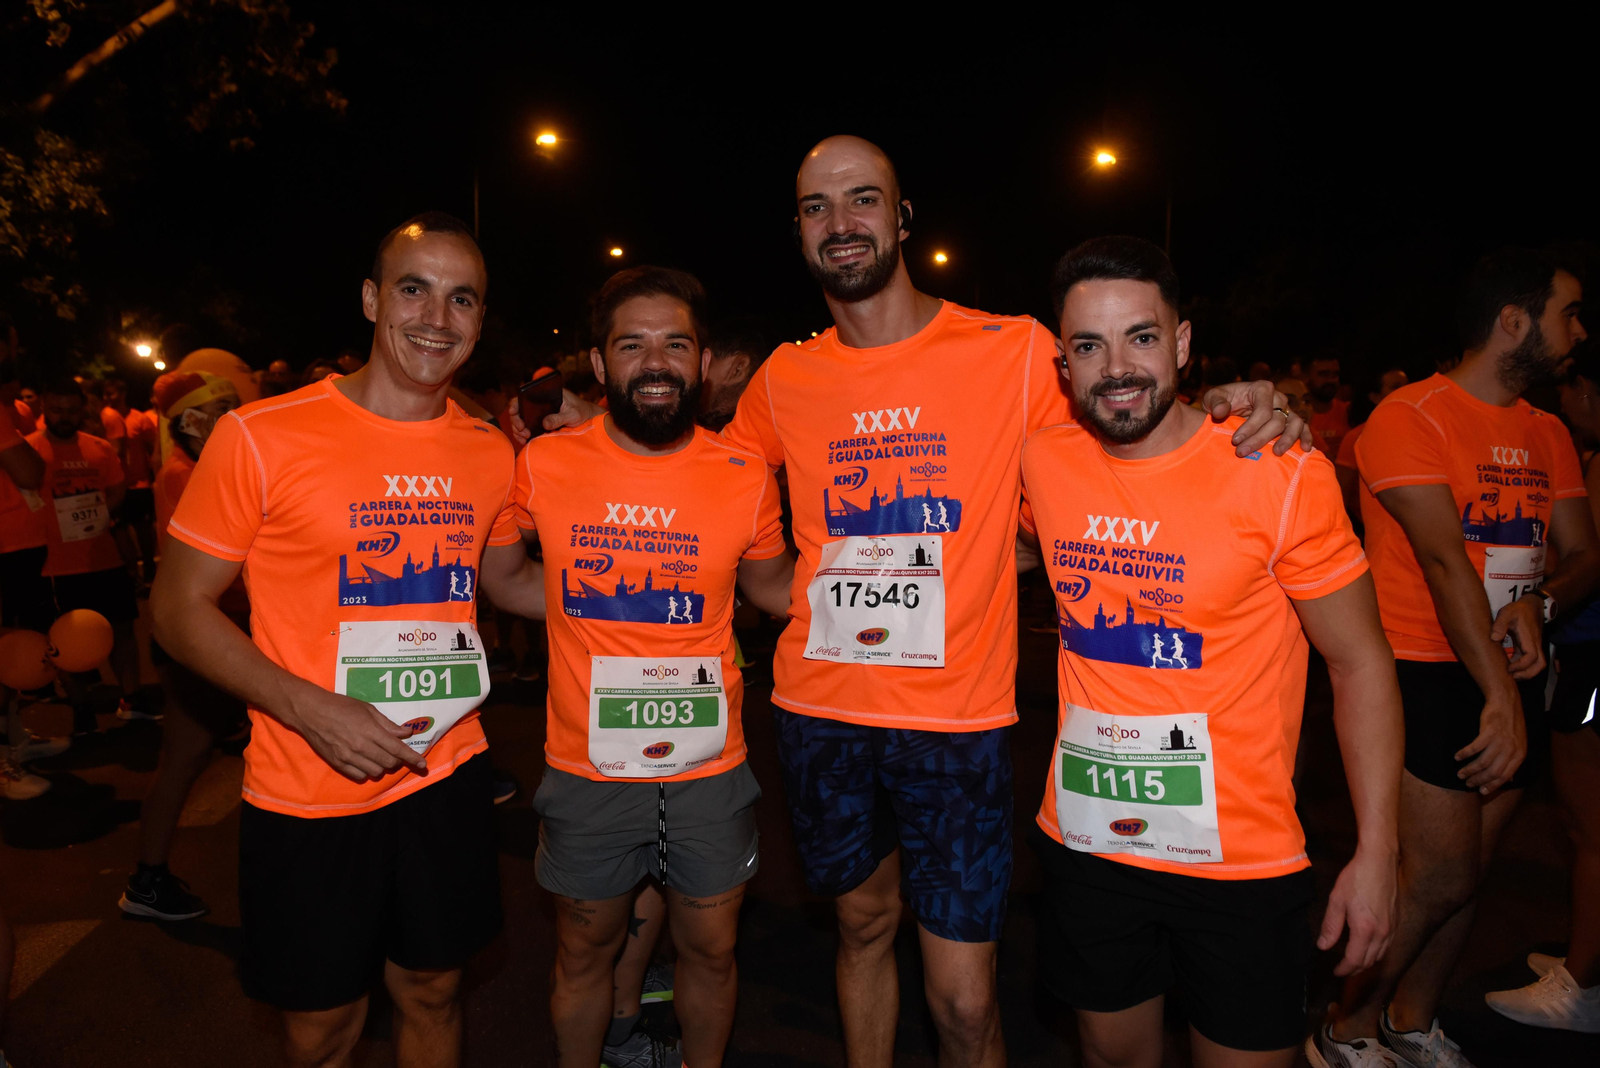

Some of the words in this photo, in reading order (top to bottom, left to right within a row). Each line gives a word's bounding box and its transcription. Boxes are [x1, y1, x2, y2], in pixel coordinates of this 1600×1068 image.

[852, 406, 922, 434] XXXV
[828, 437, 878, 450] CARRERA
[882, 432, 947, 444] NOCTURNA
[836, 444, 947, 463] GUADALQUIVIR
[1490, 446, 1529, 466] XXXV
[1504, 468, 1548, 478] NOCTURNA
[382, 474, 452, 498] XXXV
[72, 508, 98, 522] 9371
[349, 501, 412, 512] CARRERA
[418, 501, 474, 512] NOCTURNA
[603, 502, 677, 528] XXXV
[360, 513, 474, 527] GUADALQUIVIR
[572, 524, 628, 537] CARRERA
[633, 530, 700, 542] NOCTURNA
[1082, 514, 1160, 546] XXXV
[579, 536, 699, 556] GUADALQUIVIR
[1054, 539, 1106, 556] CARRERA
[1112, 547, 1186, 566] NOCTURNA
[1059, 553, 1184, 584] GUADALQUIVIR
[342, 596, 367, 604] 2023
[830, 582, 920, 610] 17546
[565, 606, 582, 616] 2023
[901, 652, 938, 660] Cruzcampo
[378, 668, 452, 698] 1091
[626, 700, 694, 725] 1093
[1072, 744, 1090, 754] CARRERA
[1090, 750, 1116, 760] NOCTURNA
[1086, 764, 1166, 800] 1115
[1166, 844, 1211, 856] Cruzcampo
